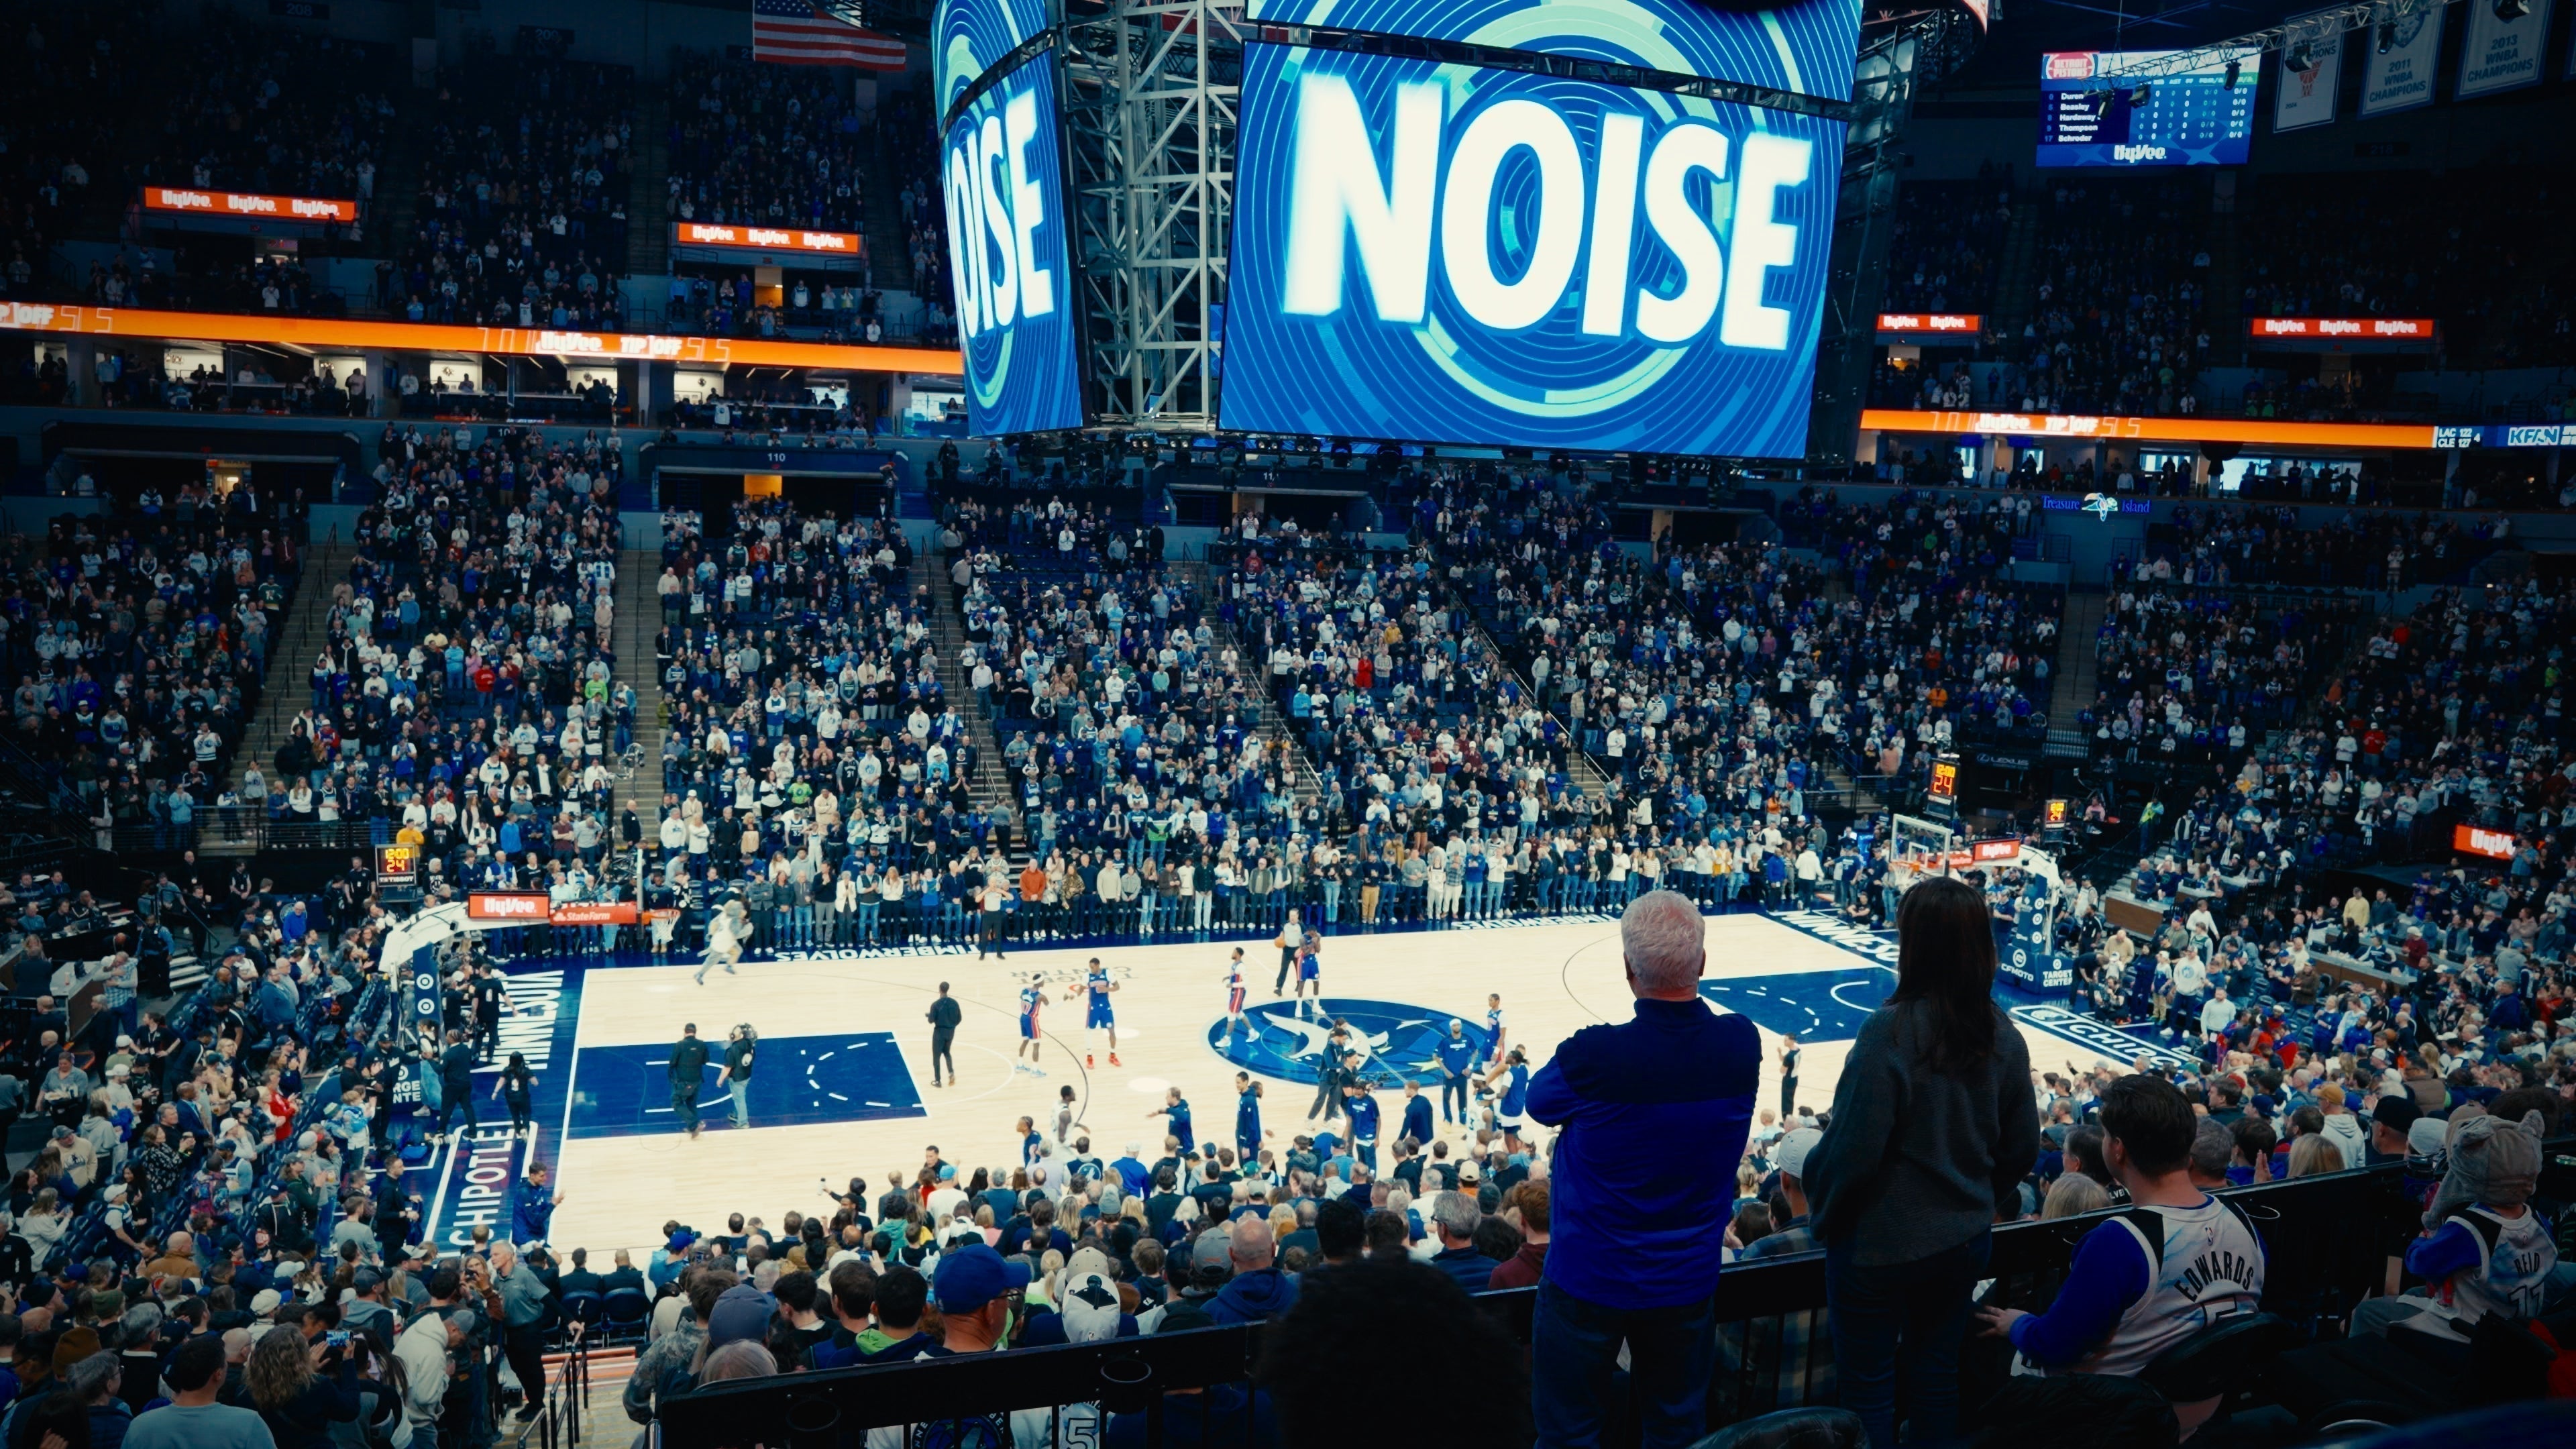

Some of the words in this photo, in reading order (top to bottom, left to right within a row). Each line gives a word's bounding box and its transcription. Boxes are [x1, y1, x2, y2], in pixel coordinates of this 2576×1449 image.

[2491, 34, 2518, 50] 2013
[2485, 49, 2518, 65] WNBA
[2388, 59, 2411, 72] 2011
[2467, 58, 2534, 83] CHAMPIONS
[2384, 71, 2413, 87] WNBA
[2369, 80, 2426, 103] CHAMPIONS
[942, 86, 1054, 338] OISE
[1284, 72, 1813, 350] NOISE
[19, 306, 54, 325] OFF
[621, 335, 647, 354] TIP
[656, 338, 682, 355] OFF
[2045, 416, 2065, 431] TIP
[2073, 418, 2098, 433] OFF
[2438, 428, 2456, 437] LAC
[2460, 428, 2473, 437] 122
[2438, 438, 2455, 447] CLE
[2458, 438, 2471, 447] 127
[767, 453, 786, 462] 110
[2041, 495, 2080, 510] Treasure
[2122, 499, 2151, 513] Island
[1990, 756, 2029, 766] LEXUS
[1933, 775, 1952, 796] 24
[385, 848, 409, 859] 12:00
[386, 859, 405, 872] 24
[1451, 914, 1621, 930] TIMBERWOLVES
[774, 944, 980, 962] TIMBERWOLVES
[2001, 963, 2035, 981] CFMOTO
[2043, 969, 2073, 979] TARGET
[2043, 977, 2073, 987] CENTER
[392, 1080, 421, 1093] RGE
[392, 1091, 421, 1104] NTE
[449, 1128, 515, 1246] CHIPOTLE
[2514, 1252, 2540, 1278] REID
[2174, 1251, 2254, 1302] EDWARDS
